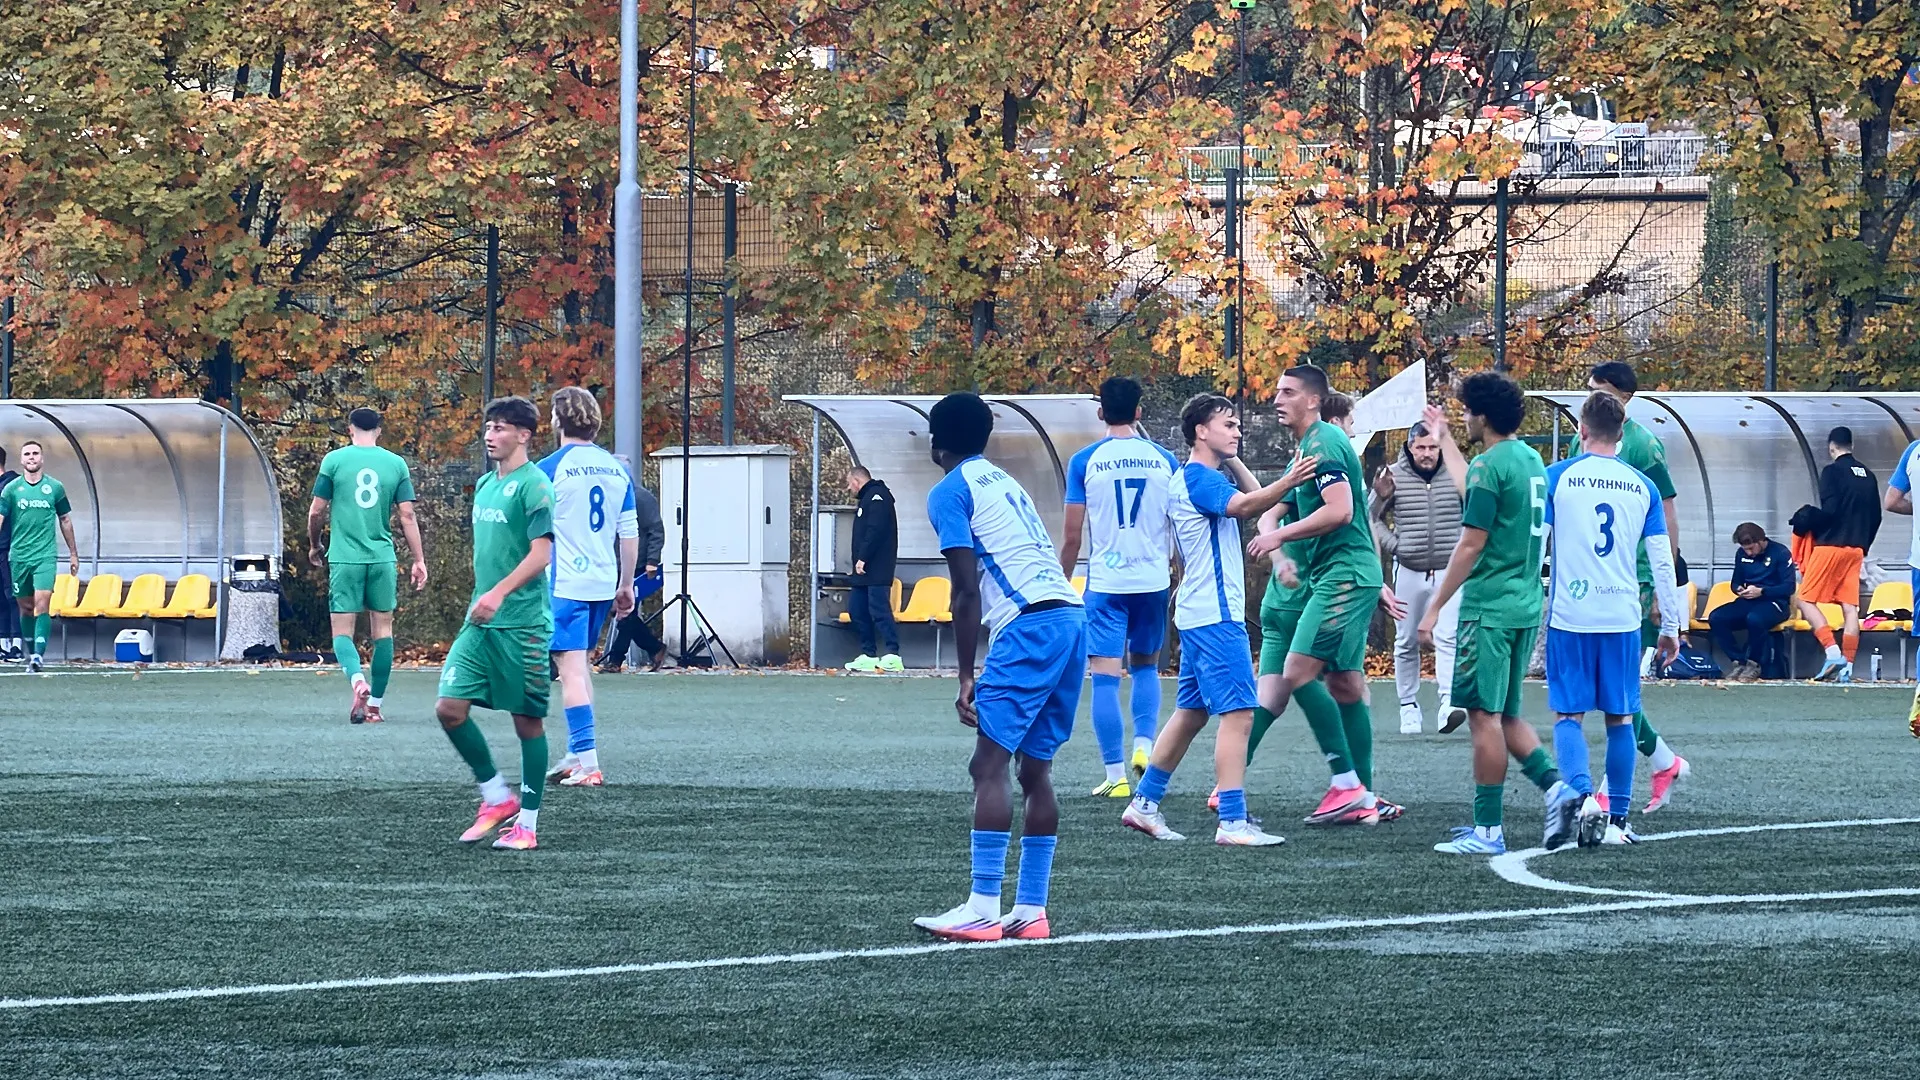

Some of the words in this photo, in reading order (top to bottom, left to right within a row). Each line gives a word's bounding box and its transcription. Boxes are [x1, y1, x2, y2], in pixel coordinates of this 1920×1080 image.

[565, 467, 581, 477] NK
[975, 474, 993, 488] NK
[1095, 461, 1112, 473] NK
[1114, 458, 1162, 470] VRHNIKA
[1568, 477, 1585, 488] NK
[1588, 477, 1642, 494] VRHNIKA
[355, 467, 379, 509] 8
[589, 485, 605, 533] 8
[1114, 478, 1147, 530] 17
[1530, 476, 1546, 537] 5
[1594, 502, 1615, 558] 3
